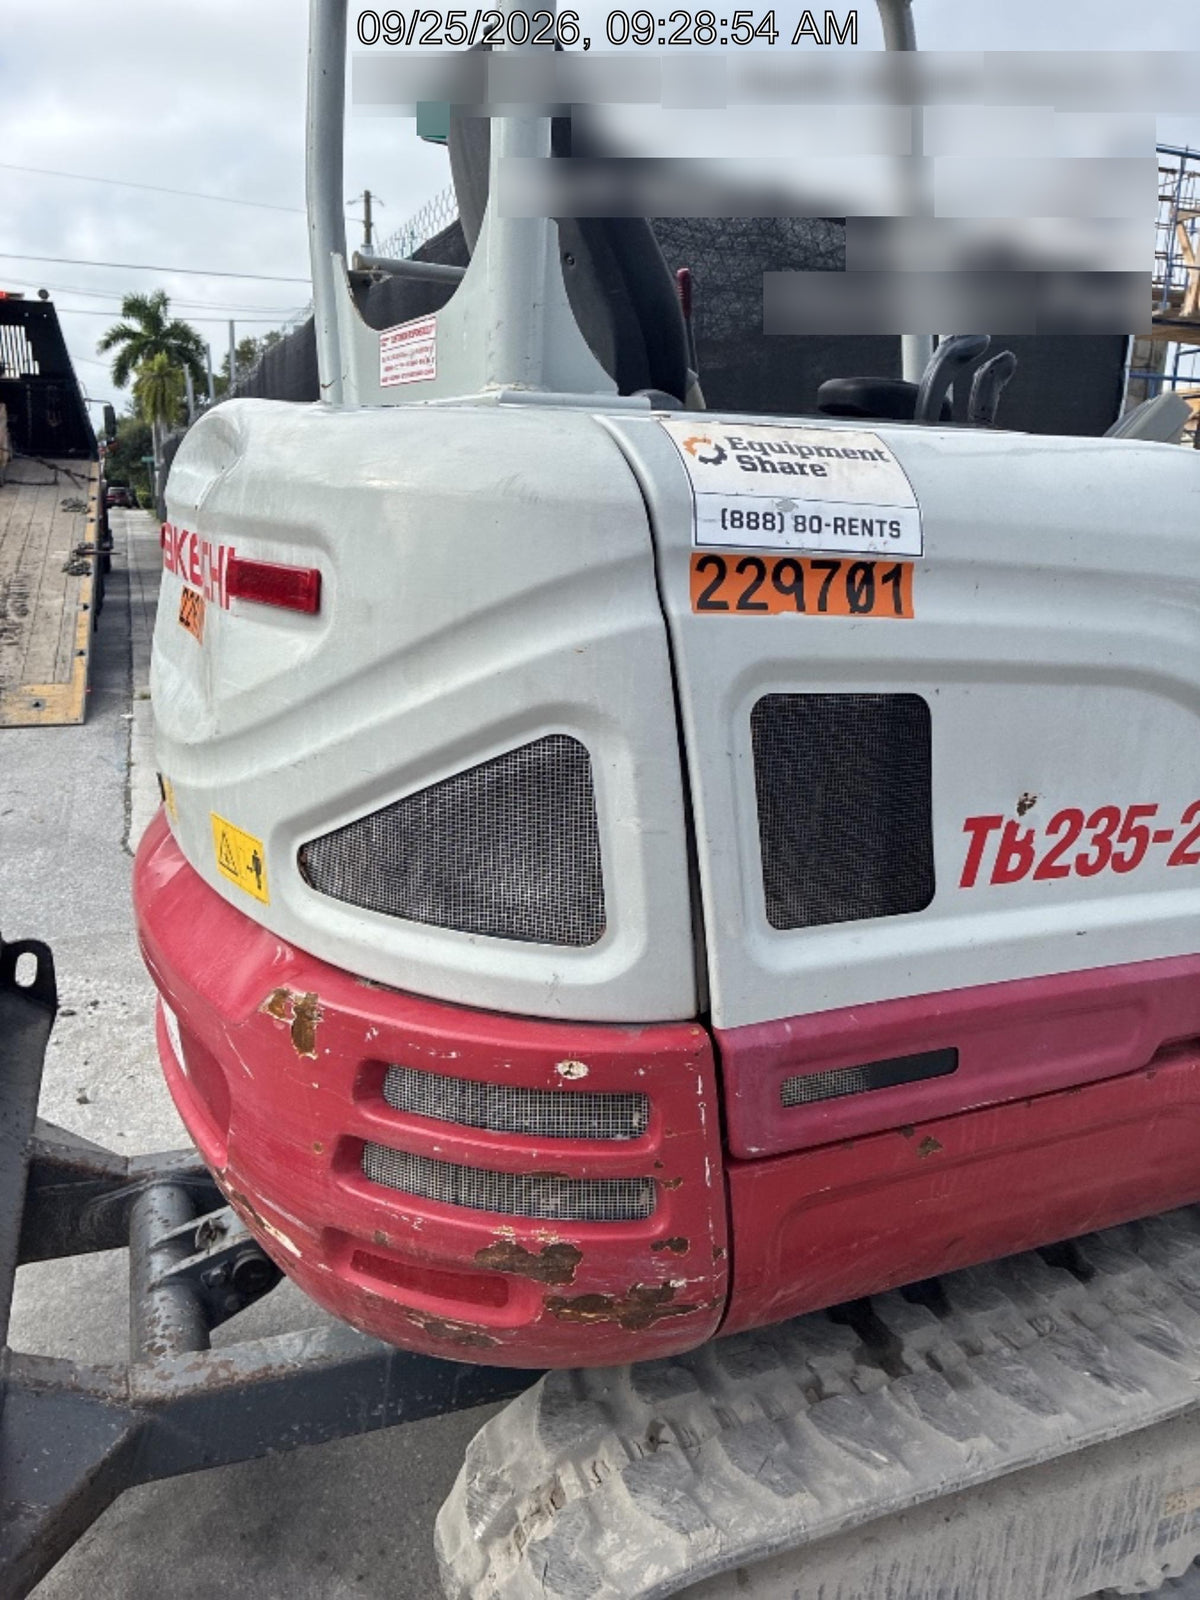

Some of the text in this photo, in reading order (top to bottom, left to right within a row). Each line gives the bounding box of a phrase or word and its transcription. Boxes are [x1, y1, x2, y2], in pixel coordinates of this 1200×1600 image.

[723, 436, 890, 463] Equipment
[736, 454, 828, 477] Share
[721, 508, 785, 534] (888)
[695, 555, 903, 615] 229701
